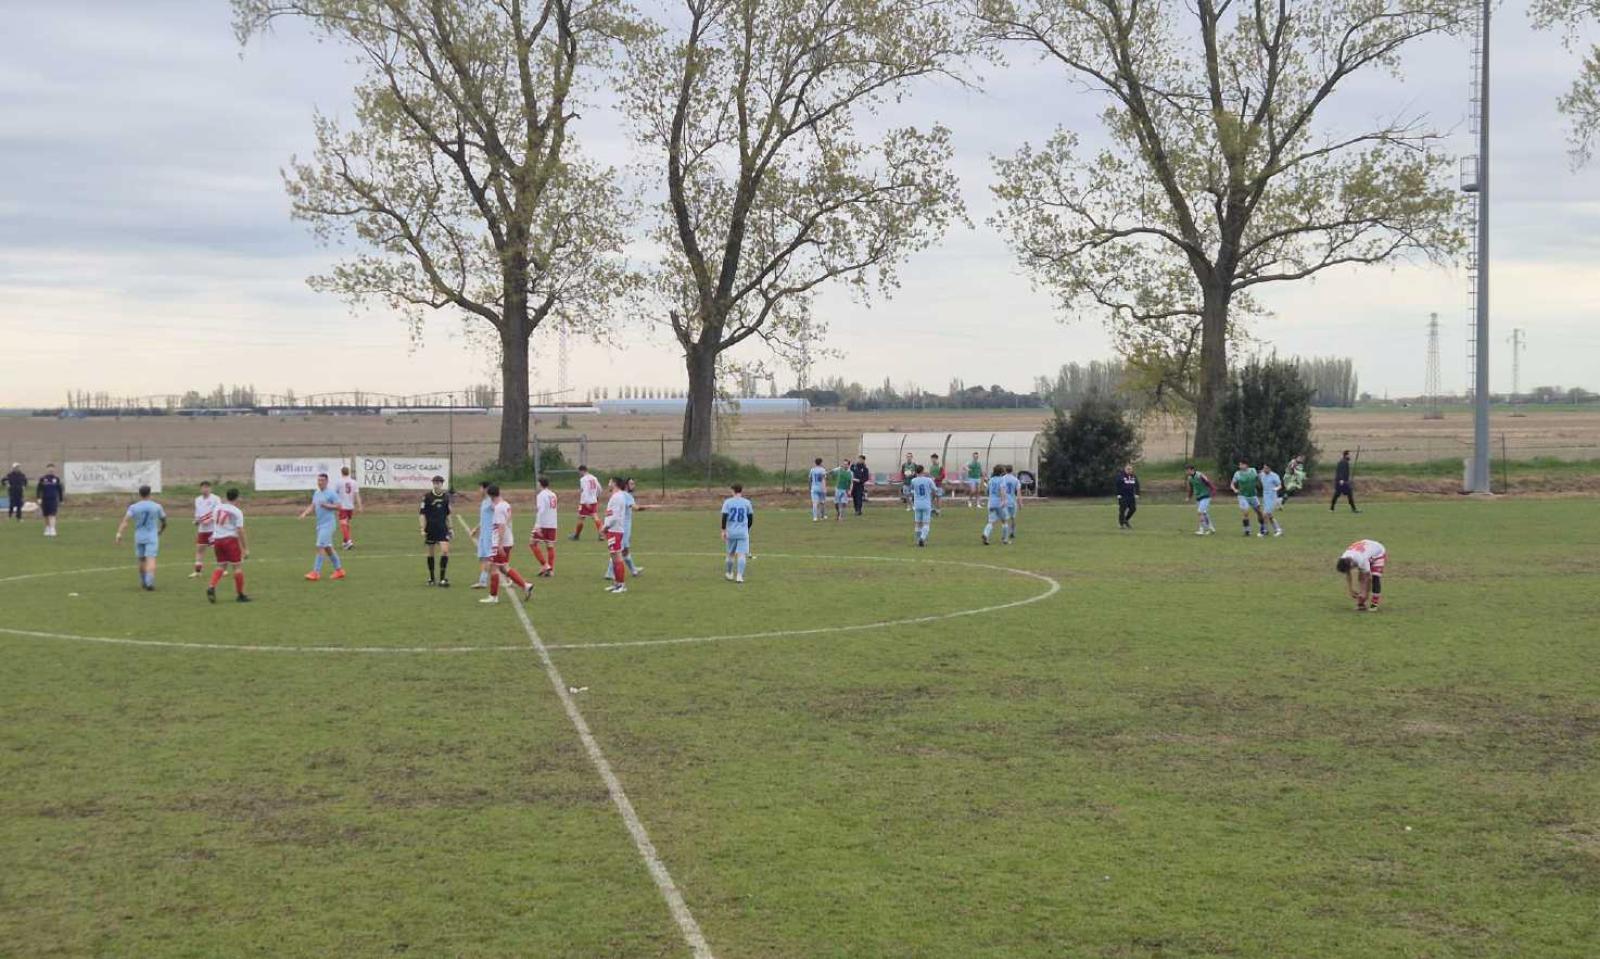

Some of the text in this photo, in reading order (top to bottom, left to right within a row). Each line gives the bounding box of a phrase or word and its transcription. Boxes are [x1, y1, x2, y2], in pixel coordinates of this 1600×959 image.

[274, 463, 314, 473] Allianz
[141, 511, 149, 526] 7
[216, 510, 230, 526] 17
[729, 507, 745, 522] 28
